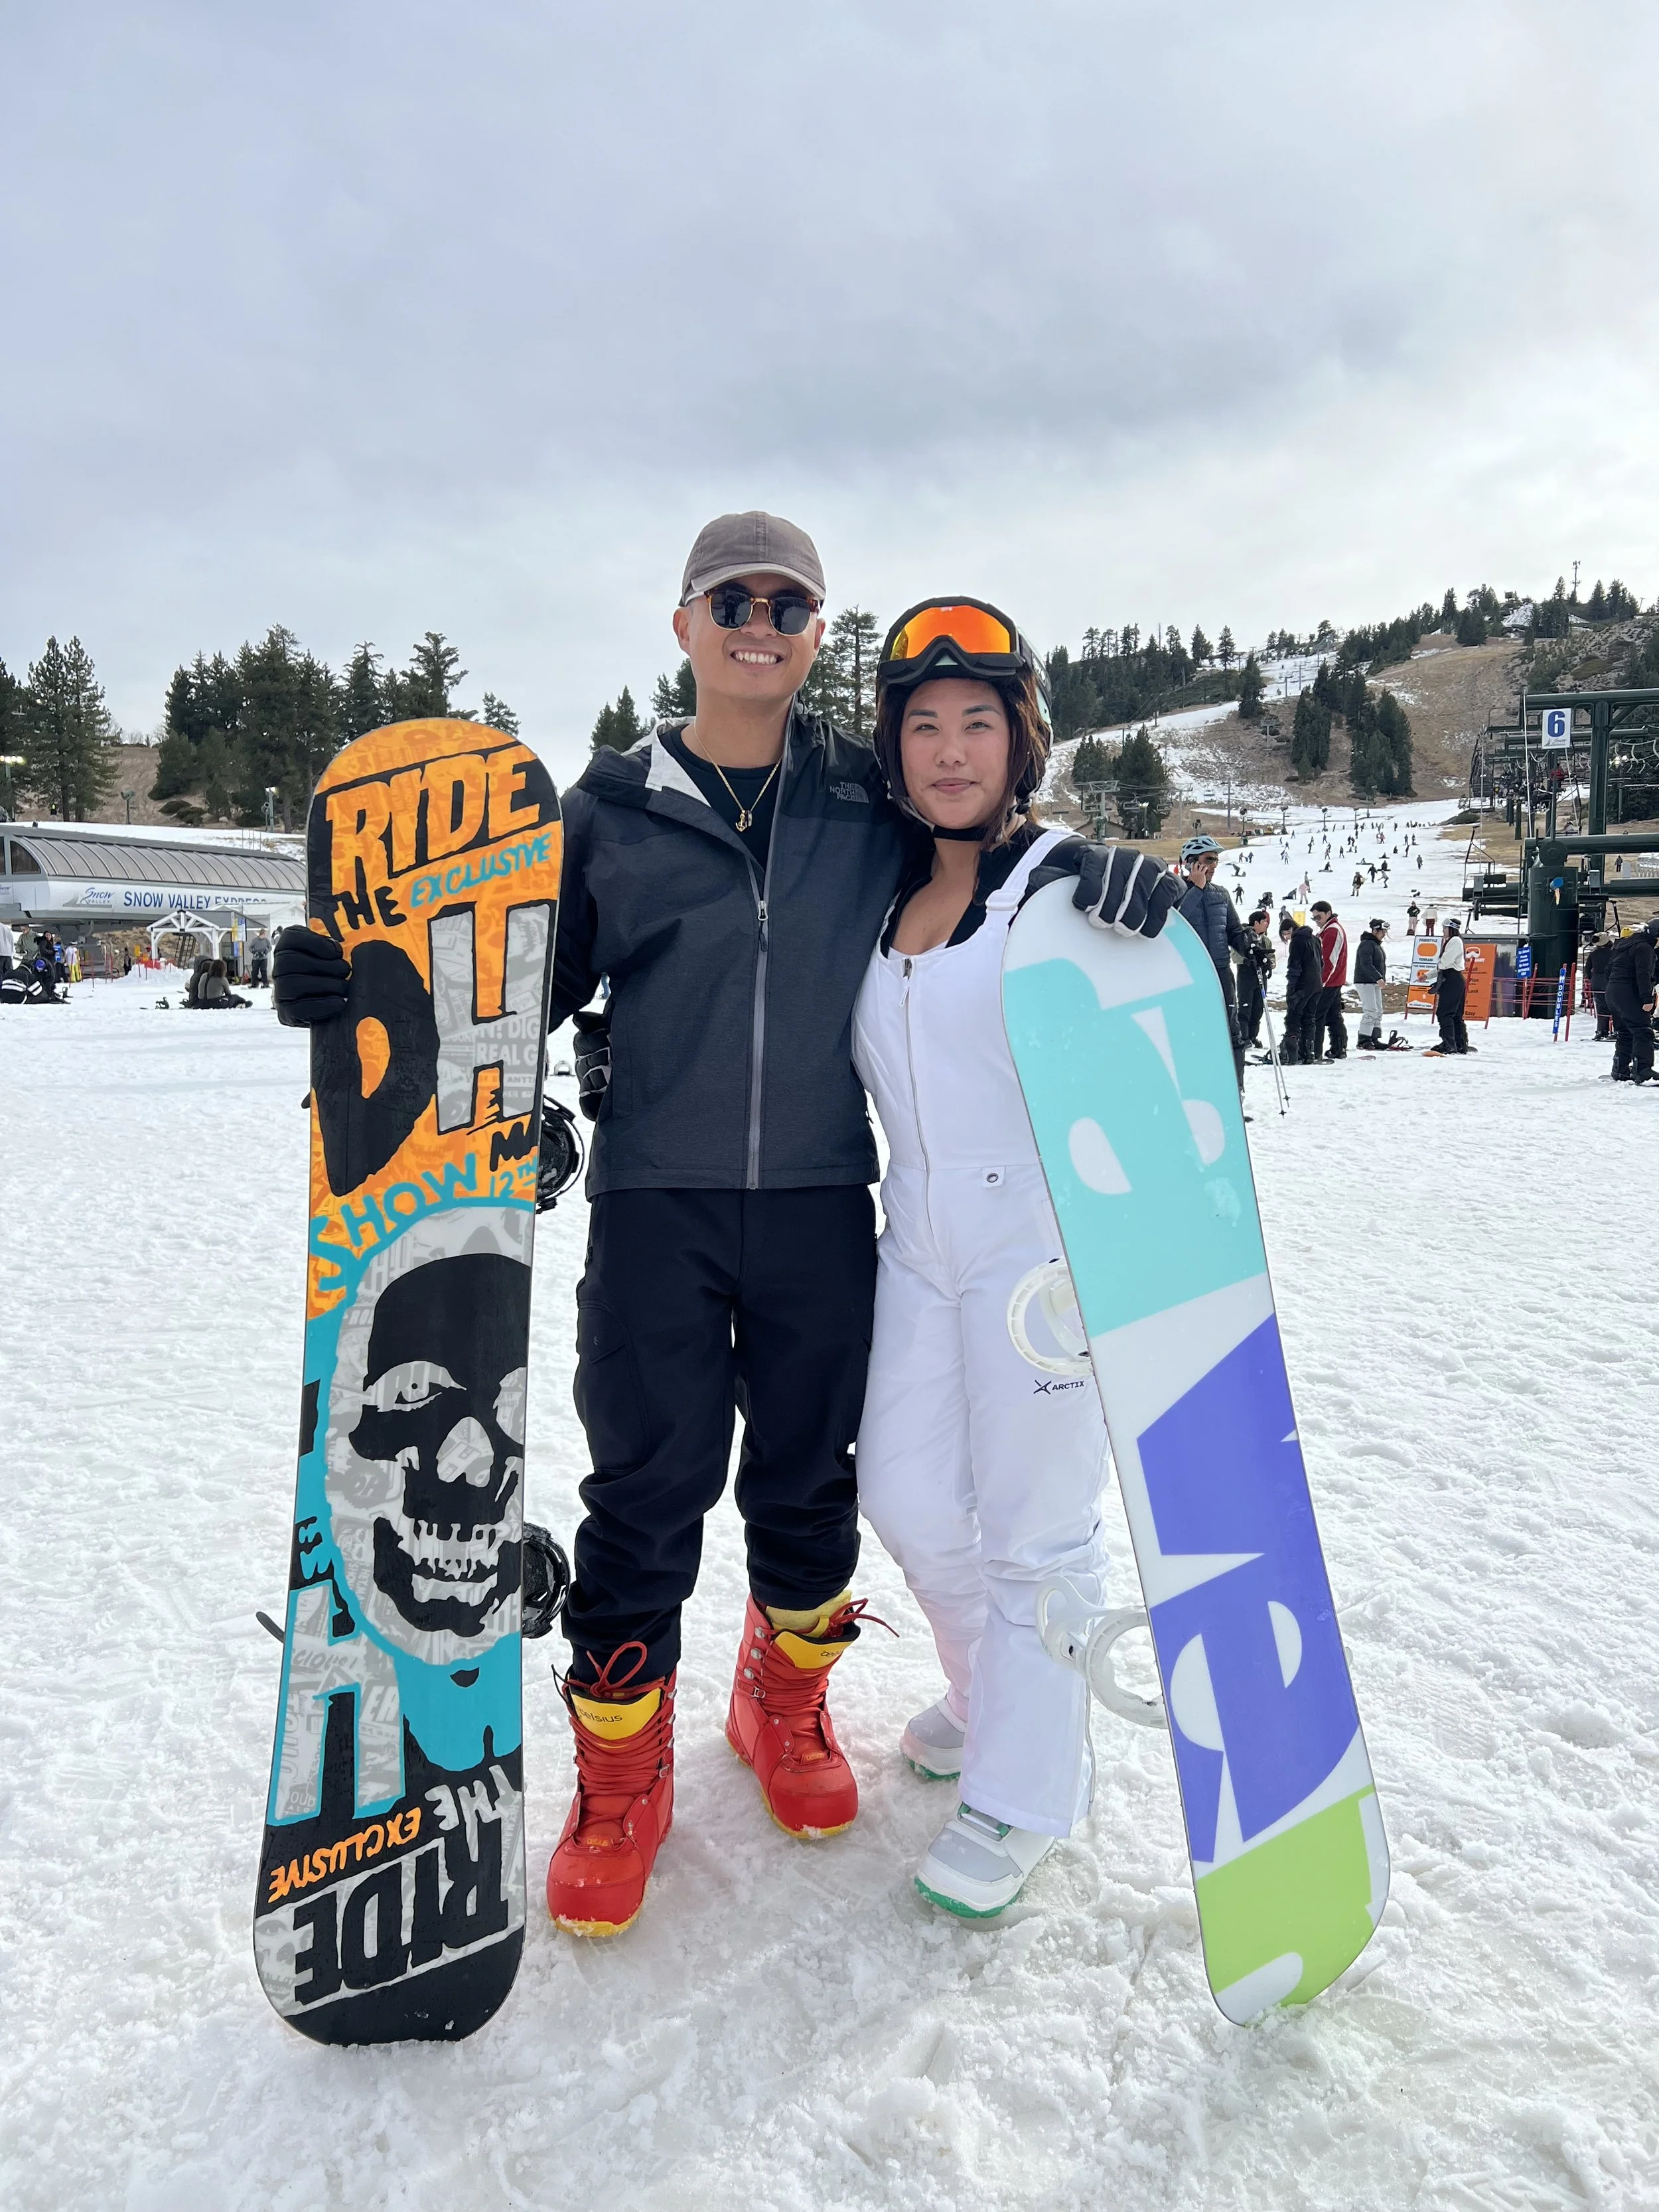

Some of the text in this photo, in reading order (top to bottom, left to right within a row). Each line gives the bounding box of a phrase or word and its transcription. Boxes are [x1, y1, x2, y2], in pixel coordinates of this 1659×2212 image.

[1548, 710, 1565, 737] 6
[830, 785, 855, 796] NORTH
[837, 793, 855, 802] FACE
[325, 745, 540, 893] RIDE
[409, 832, 553, 909] EXCLUSIVE
[123, 891, 165, 909] SNOW
[167, 893, 211, 910] VALLEY
[317, 885, 407, 942] THE
[1553, 985, 1563, 1027] DOUBLES
[475, 1042, 521, 1067] REAL
[1052, 1380, 1084, 1390] ARCTIX
[267, 1806, 421, 1903] EXCLUSIVE
[293, 1822, 510, 2006] RIDE
